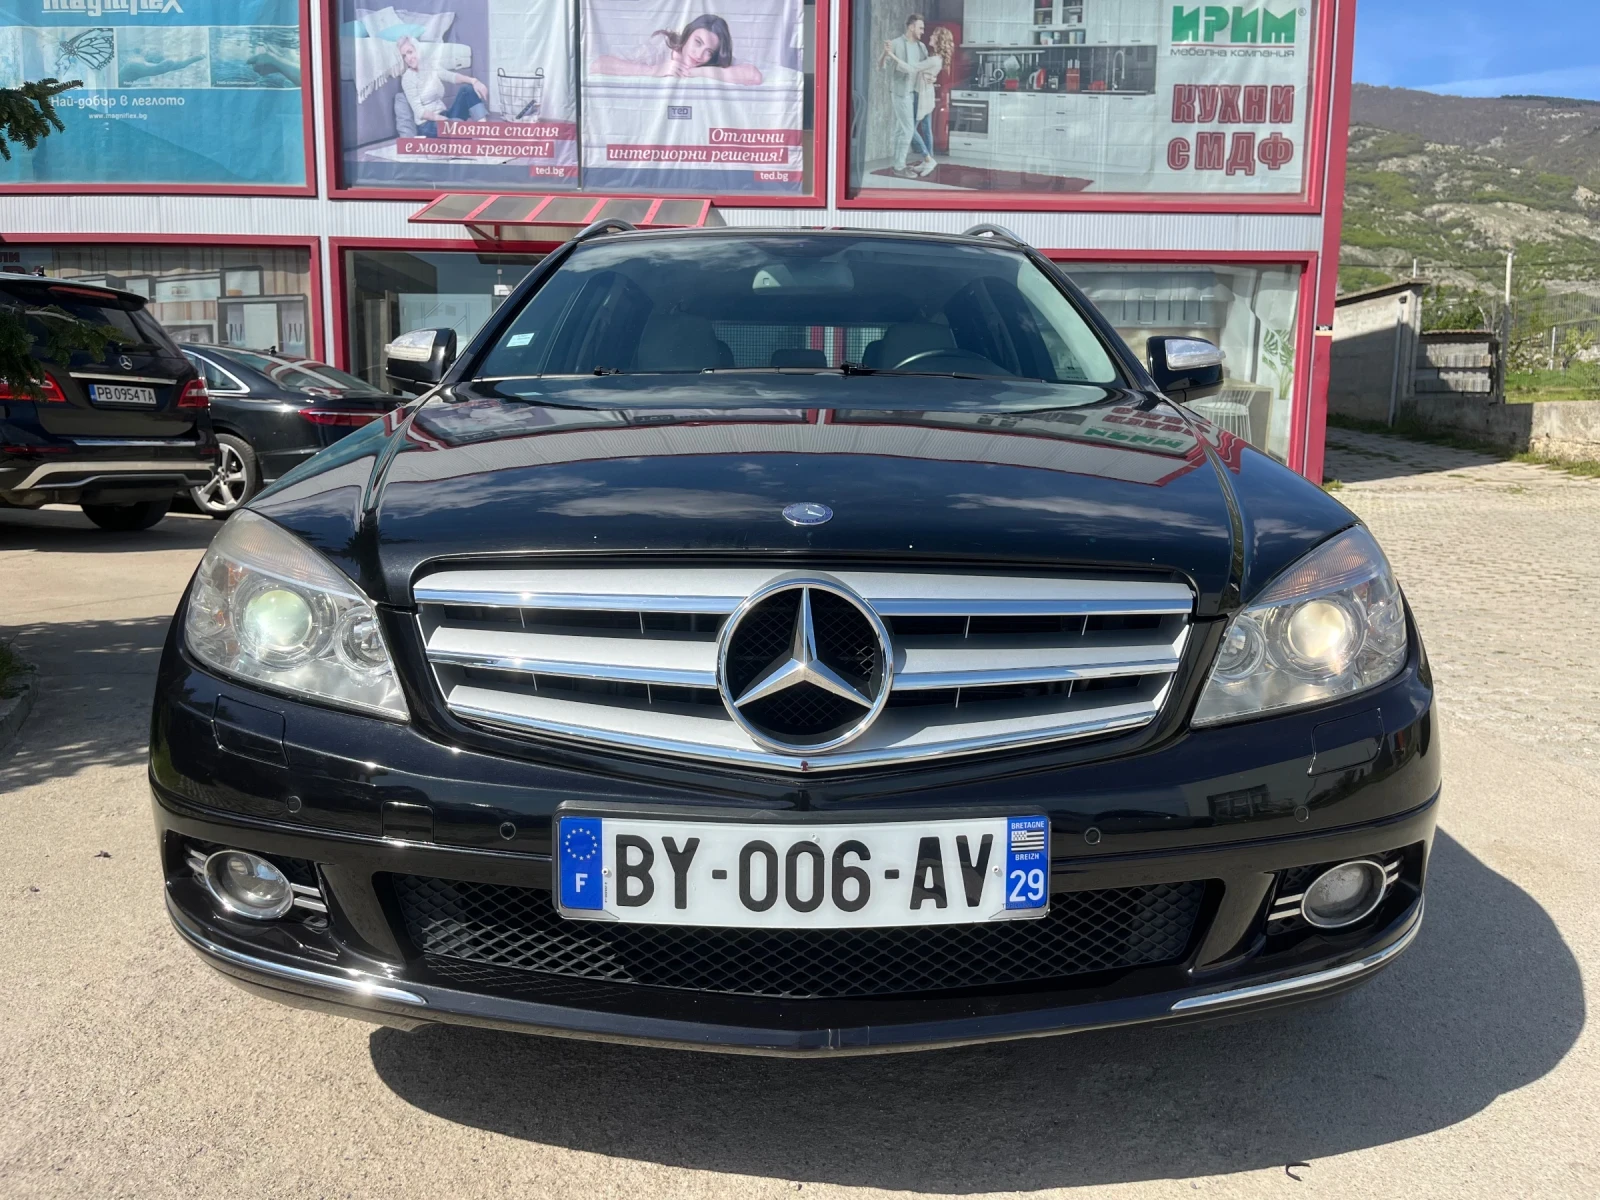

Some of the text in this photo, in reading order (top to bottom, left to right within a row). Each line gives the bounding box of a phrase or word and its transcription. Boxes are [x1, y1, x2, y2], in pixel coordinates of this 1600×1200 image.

[1171, 6, 1296, 43] ИРИМ
[51, 95, 116, 109] Най-добър
[120, 95, 128, 106] в
[1171, 84, 1295, 123] КУХНИ
[442, 122, 560, 137] Моята спалня
[711, 129, 785, 143] Отлични
[405, 142, 550, 157] е моята крепост!
[609, 148, 783, 163] интериорни решения!
[535, 167, 565, 177] ted.bg
[760, 171, 789, 182] ted.bg
[96, 386, 155, 402] PB 0954 TA
[1011, 821, 1044, 830] BRETAGNE
[1015, 853, 1040, 861] BREIZH
[616, 834, 993, 912] BY-006-AV
[575, 872, 588, 893] F
[1009, 868, 1045, 902] 29
